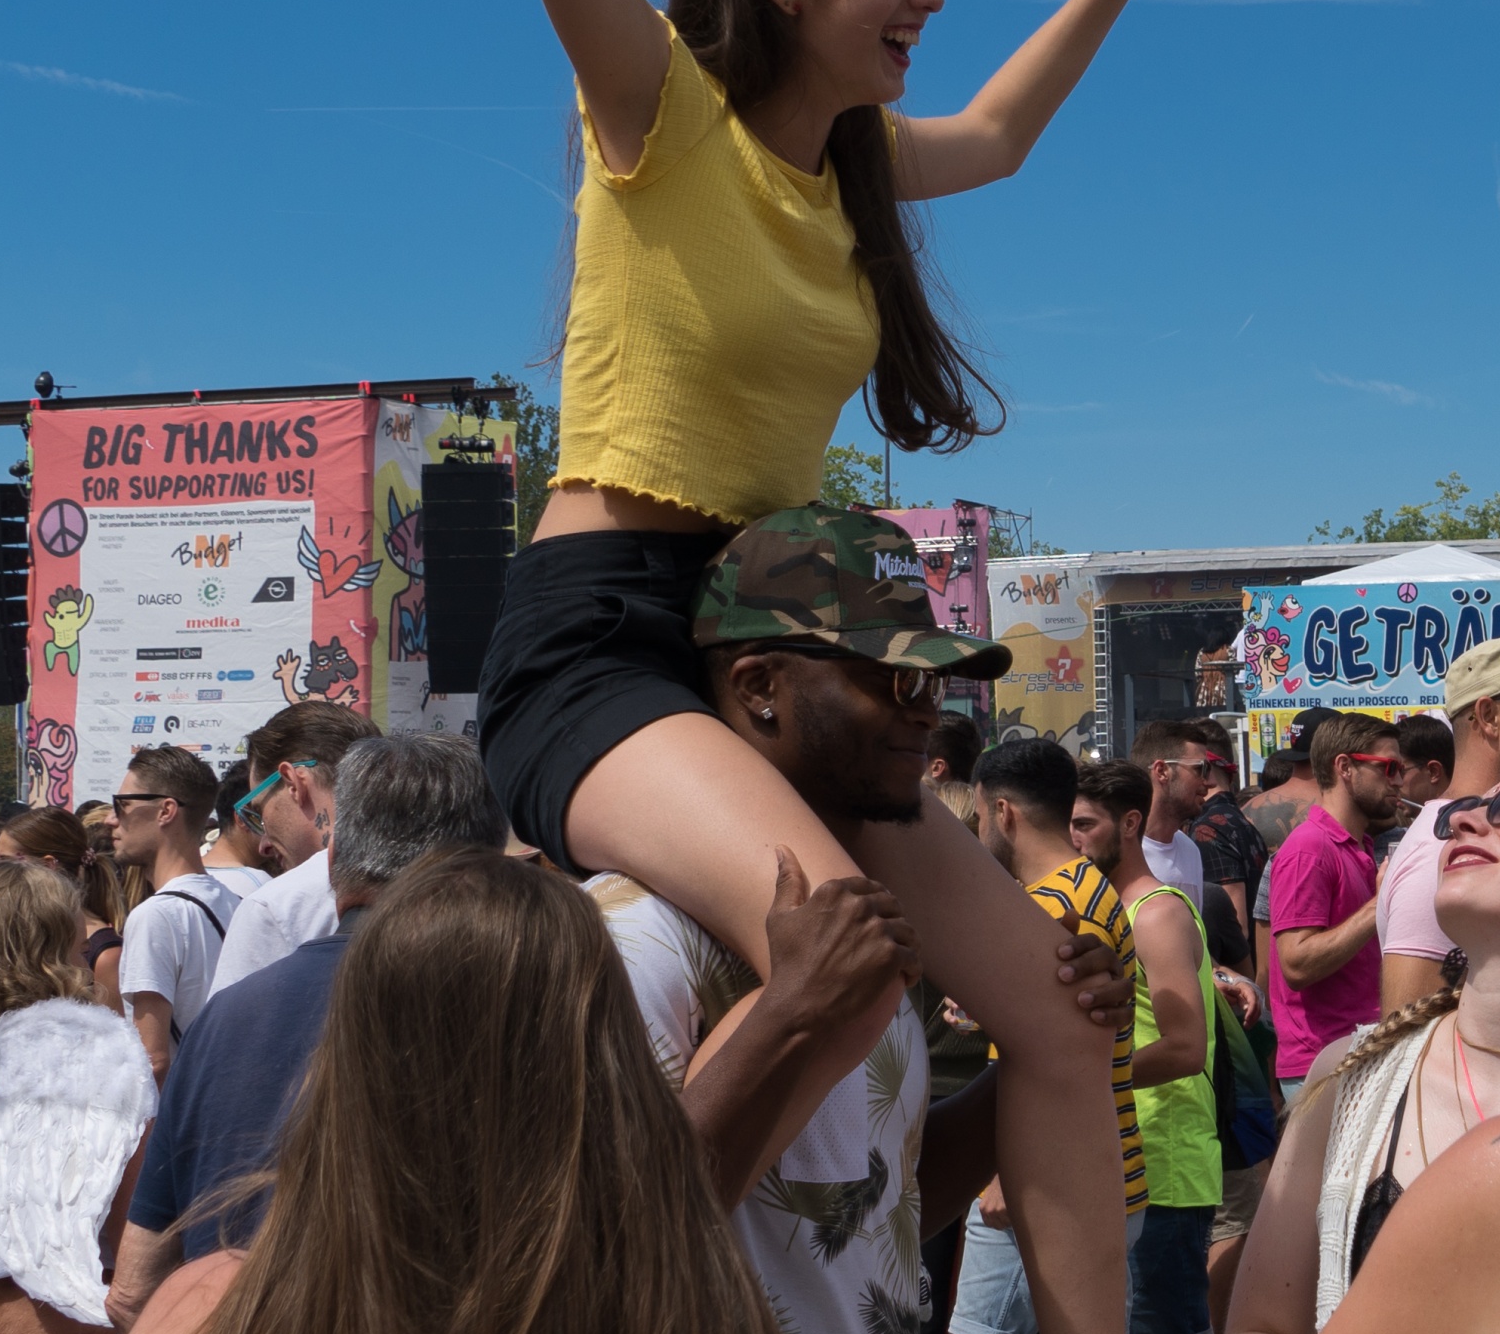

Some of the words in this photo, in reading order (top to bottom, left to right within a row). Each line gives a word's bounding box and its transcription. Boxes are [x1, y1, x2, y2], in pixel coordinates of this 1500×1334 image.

[83, 423, 145, 469] BIG
[162, 415, 318, 464] THANKS
[82, 476, 120, 502] FOR
[128, 471, 267, 502] SUPPORTING
[276, 468, 315, 498] US!
[246, 509, 276, 517] Sponsoren
[171, 531, 243, 567] Budget
[1001, 570, 1069, 605] Budget
[137, 593, 182, 605] DIAGEO
[186, 616, 240, 629] medica
[1045, 617, 1078, 625] presents:
[179, 672, 195, 680] CFF
[196, 672, 212, 680] FFS
[1001, 671, 1056, 684] street
[1026, 678, 1084, 695] parade
[1250, 698, 1297, 708] HEINEKEN
[1300, 697, 1322, 708] BIER
[1332, 697, 1355, 707] RICH
[1358, 696, 1409, 706] PROSECCO
[1420, 695, 1440, 705] RED
